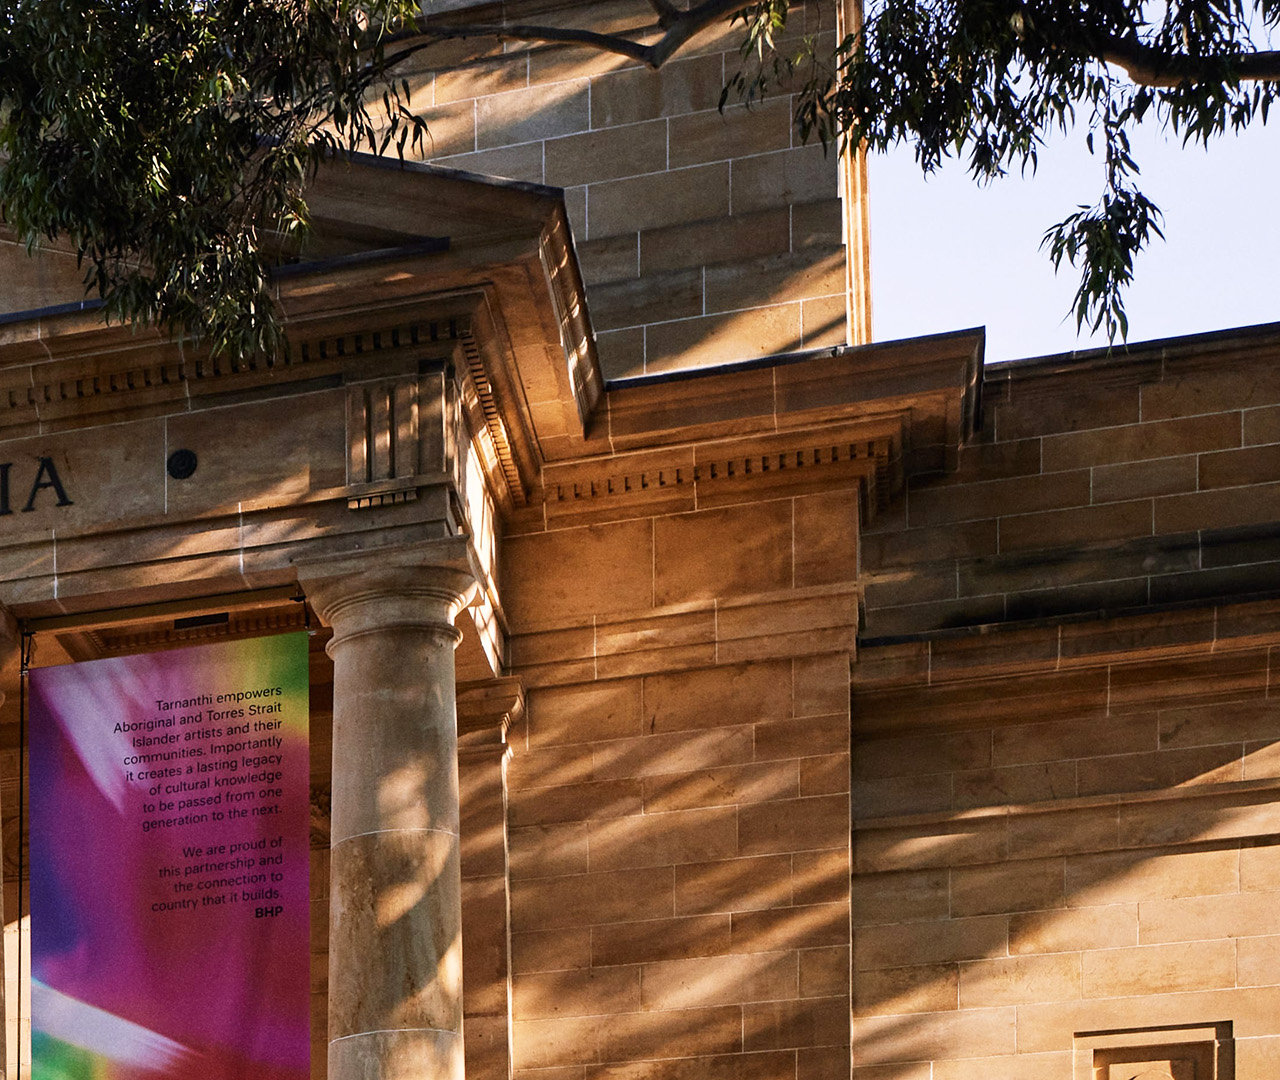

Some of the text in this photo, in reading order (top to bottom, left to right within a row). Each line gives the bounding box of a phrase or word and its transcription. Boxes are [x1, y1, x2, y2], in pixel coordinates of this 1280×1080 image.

[156, 688, 282, 711] Tarnanthi empowers
[114, 702, 281, 734] Aboriginal and Torres Strait
[133, 719, 282, 747] Islander artists and their
[124, 736, 282, 765] communities. Importantly
[126, 755, 282, 781] it creates a lasting legacy
[149, 770, 282, 796] of cultural knowledge
[143, 788, 282, 813] to be passed from one
[142, 804, 282, 832] generation to the next.
[182, 836, 283, 858] We are proud of
[159, 854, 282, 878] this partnership and
[174, 872, 283, 892] the connection to
[152, 899, 198, 912] country
[202, 894, 226, 906] that
[230, 892, 237, 902] it
[255, 906, 283, 918] BHP
